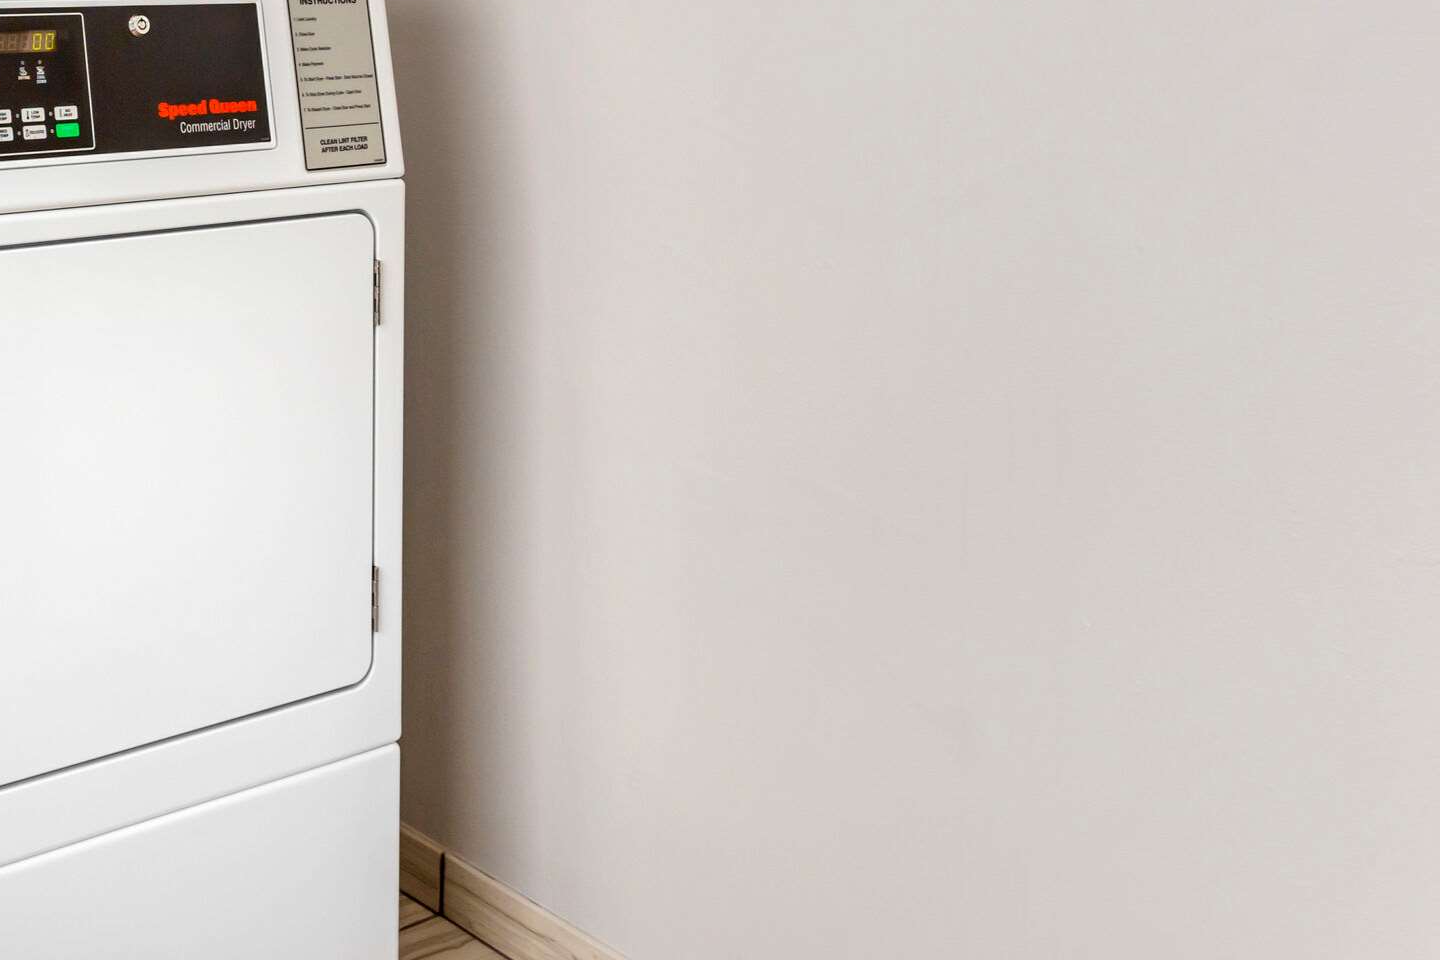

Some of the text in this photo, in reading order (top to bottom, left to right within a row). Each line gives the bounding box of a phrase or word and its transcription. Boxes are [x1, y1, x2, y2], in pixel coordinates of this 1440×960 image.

[158, 98, 256, 120] Speed Queen
[180, 118, 256, 133] Commercial Dryer
